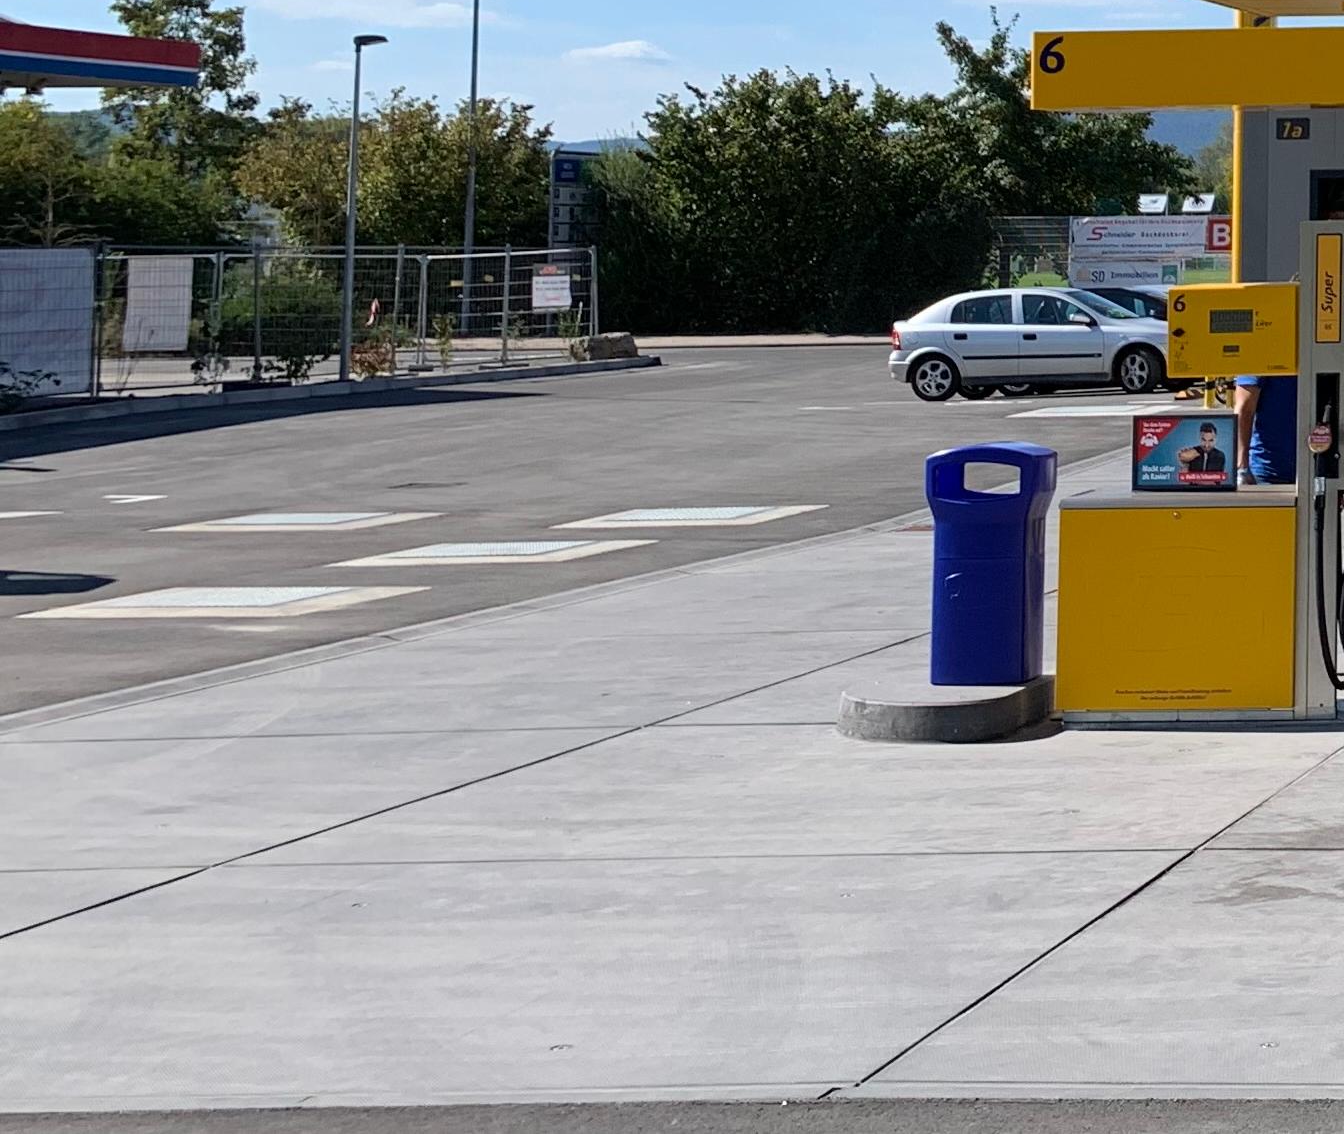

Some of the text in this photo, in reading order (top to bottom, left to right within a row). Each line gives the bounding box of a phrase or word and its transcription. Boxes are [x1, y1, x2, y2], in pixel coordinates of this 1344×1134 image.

[1039, 36, 1066, 74] 6
[1173, 293, 1186, 312] 6
[1321, 271, 1337, 313] Super
